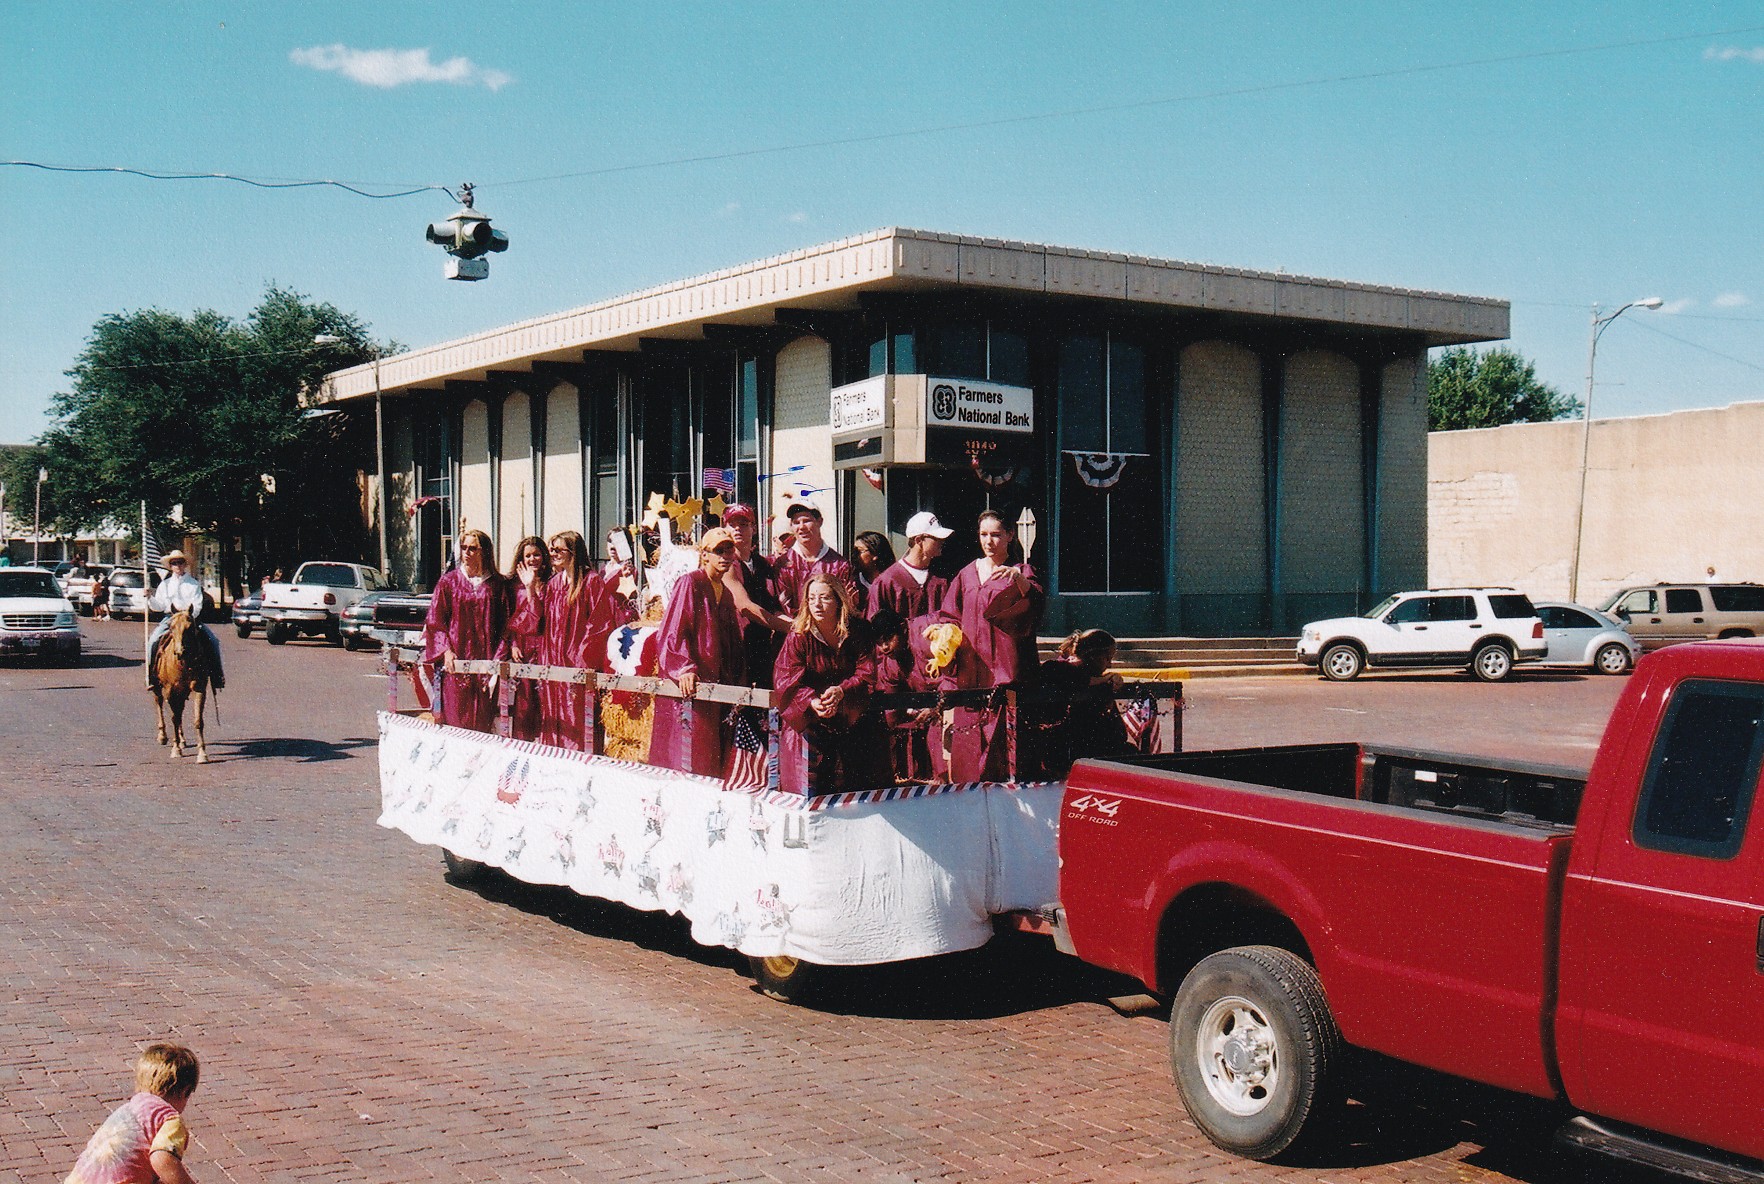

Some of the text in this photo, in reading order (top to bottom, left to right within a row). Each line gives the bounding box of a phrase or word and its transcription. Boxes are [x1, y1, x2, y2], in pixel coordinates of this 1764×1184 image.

[958, 386, 1003, 404] Farmers
[958, 407, 1030, 427] National Bank
[1068, 812, 1119, 827] OFF ROAD
